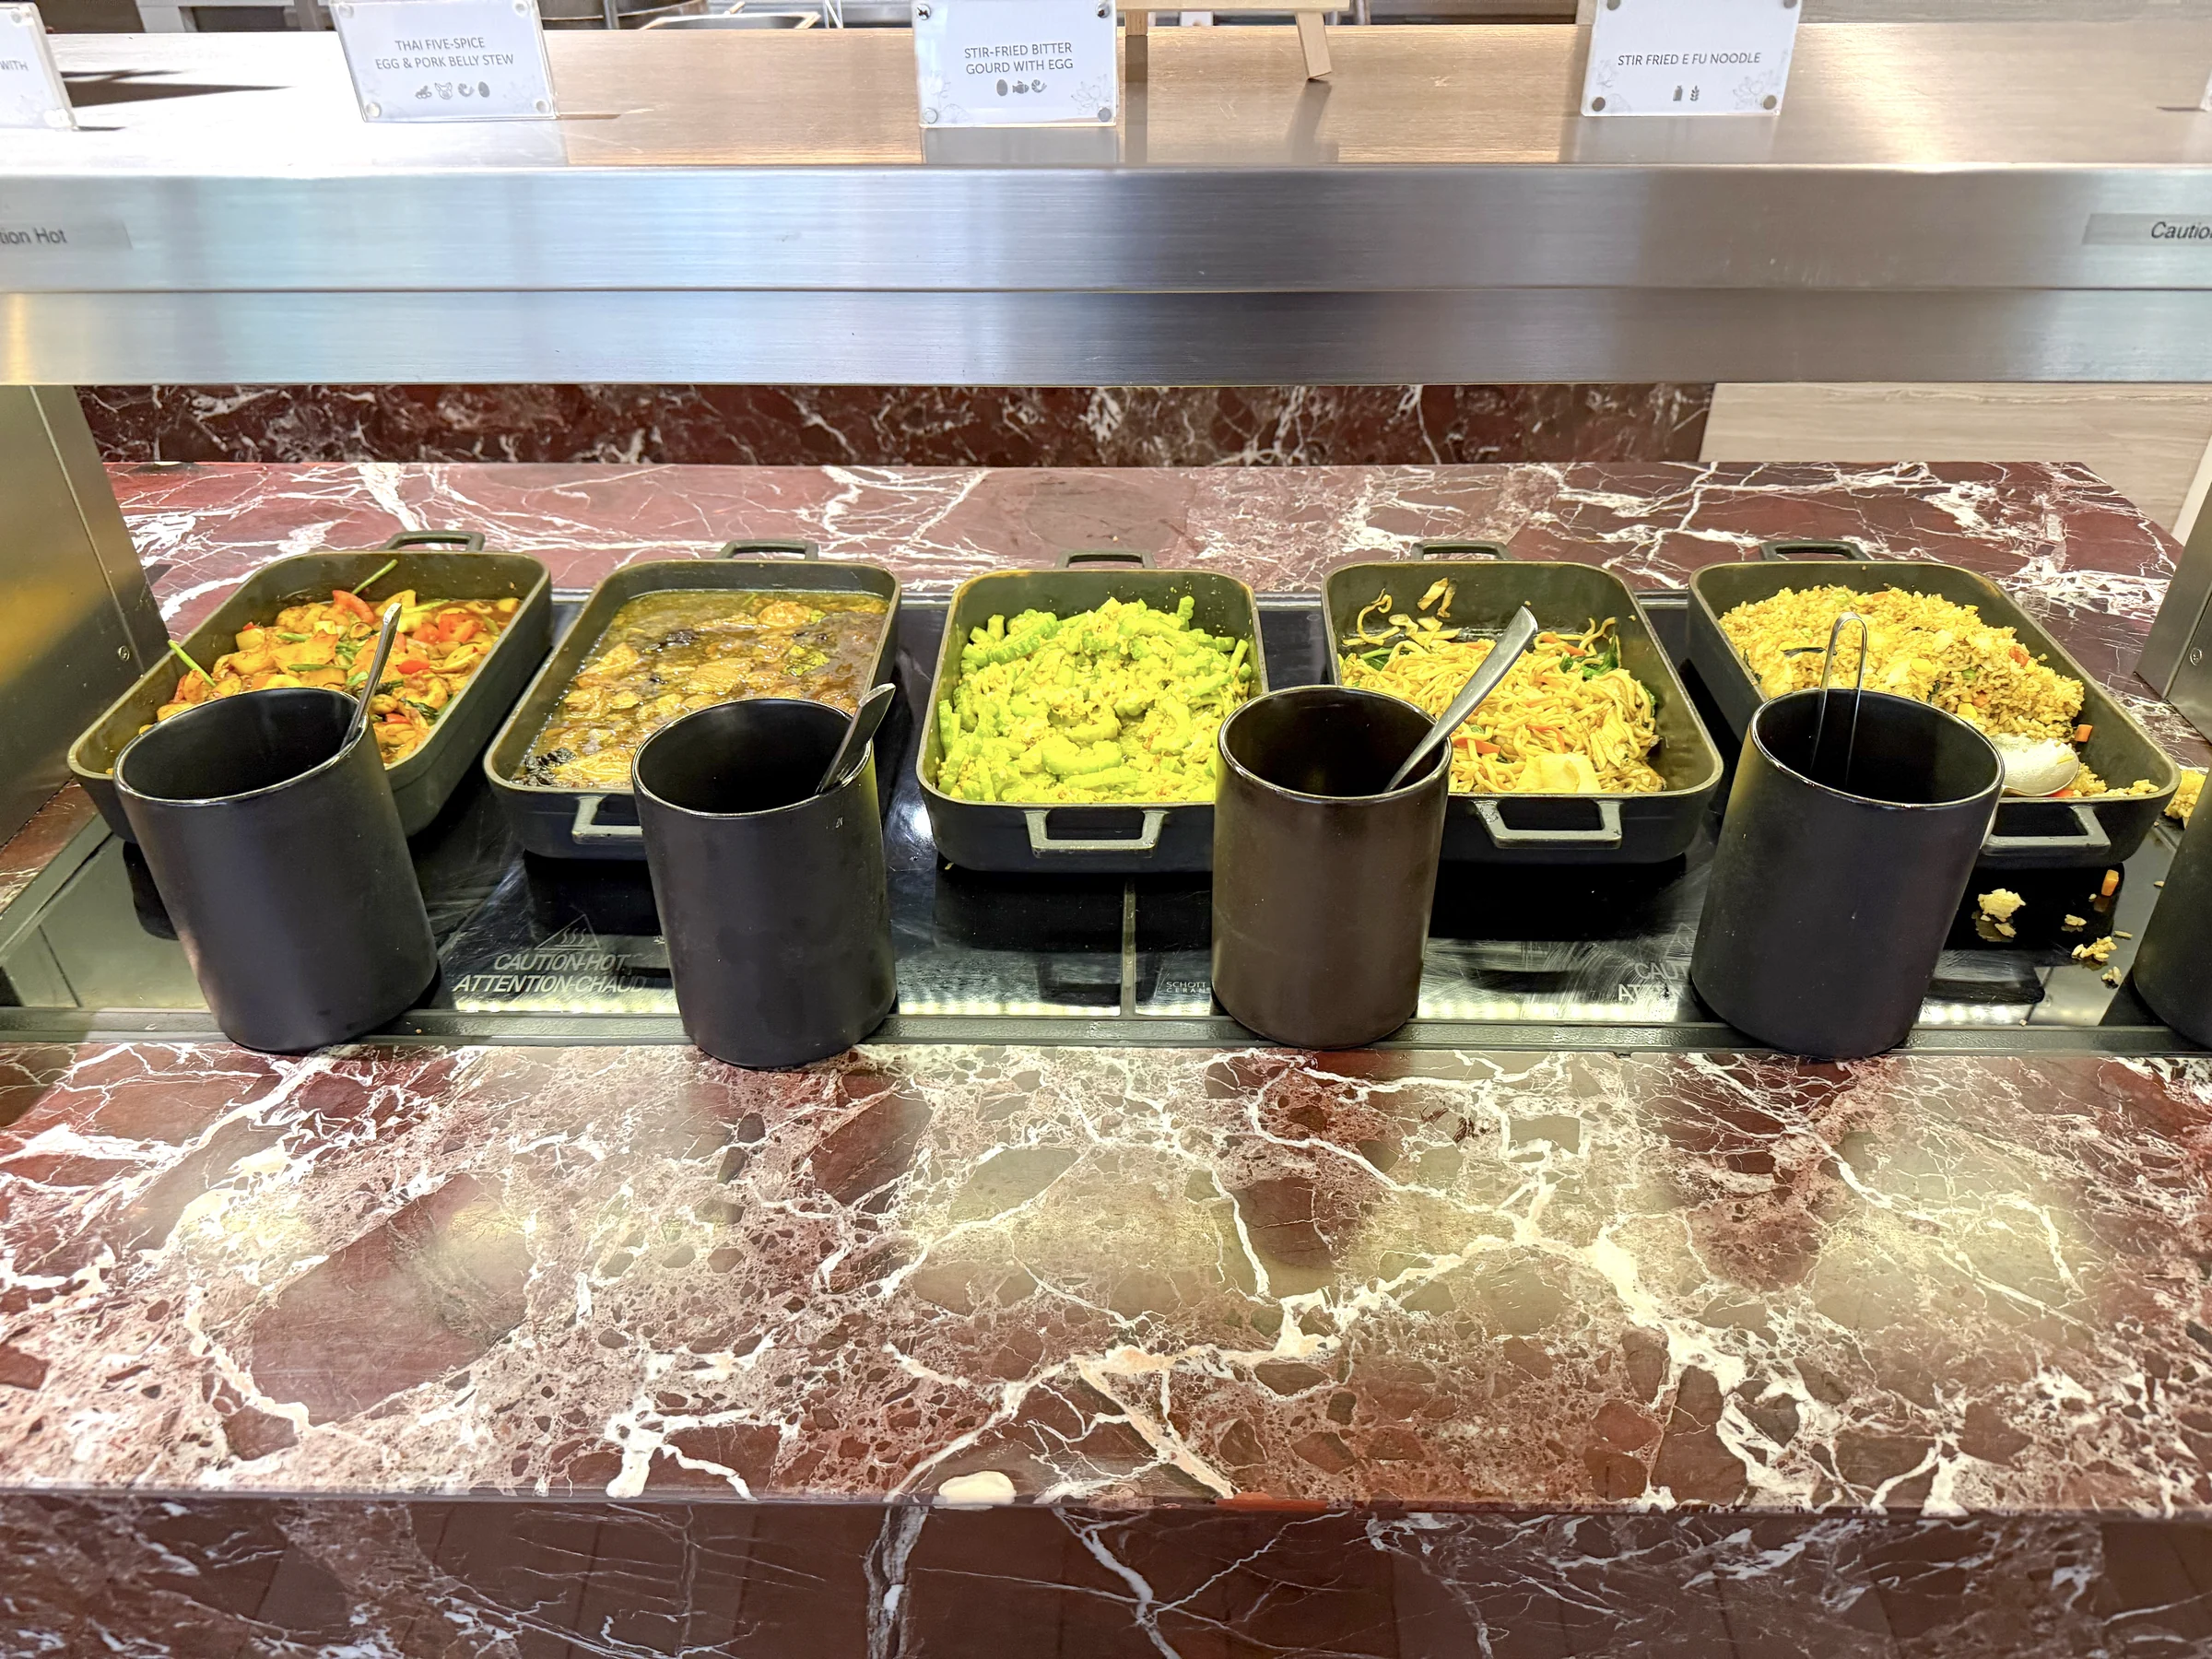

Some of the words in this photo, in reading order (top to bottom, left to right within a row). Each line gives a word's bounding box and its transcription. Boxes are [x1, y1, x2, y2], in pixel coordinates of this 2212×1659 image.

[394, 40, 423, 51] THAI
[425, 37, 486, 51] FIVE-SPICE
[964, 44, 1029, 59] STIR-FRIED
[1031, 41, 1073, 55] BITTER
[0, 60, 29, 71] WITH
[375, 58, 400, 70] EGG
[403, 57, 412, 69] &
[415, 56, 446, 68] PORK
[448, 54, 479, 67] BELLY
[482, 53, 514, 65] STEW
[966, 62, 1010, 75] GOURD
[1013, 59, 1044, 72] WITH
[1048, 58, 1074, 70] EGG
[1618, 54, 1642, 65] STIR
[1645, 53, 1679, 65] FRIED
[1682, 53, 1689, 65] E
[1691, 53, 1707, 65] FU
[1710, 52, 1761, 65] NOODLE
[33, 226, 67, 244] Hot
[2151, 221, 2212, 239] Cautio
